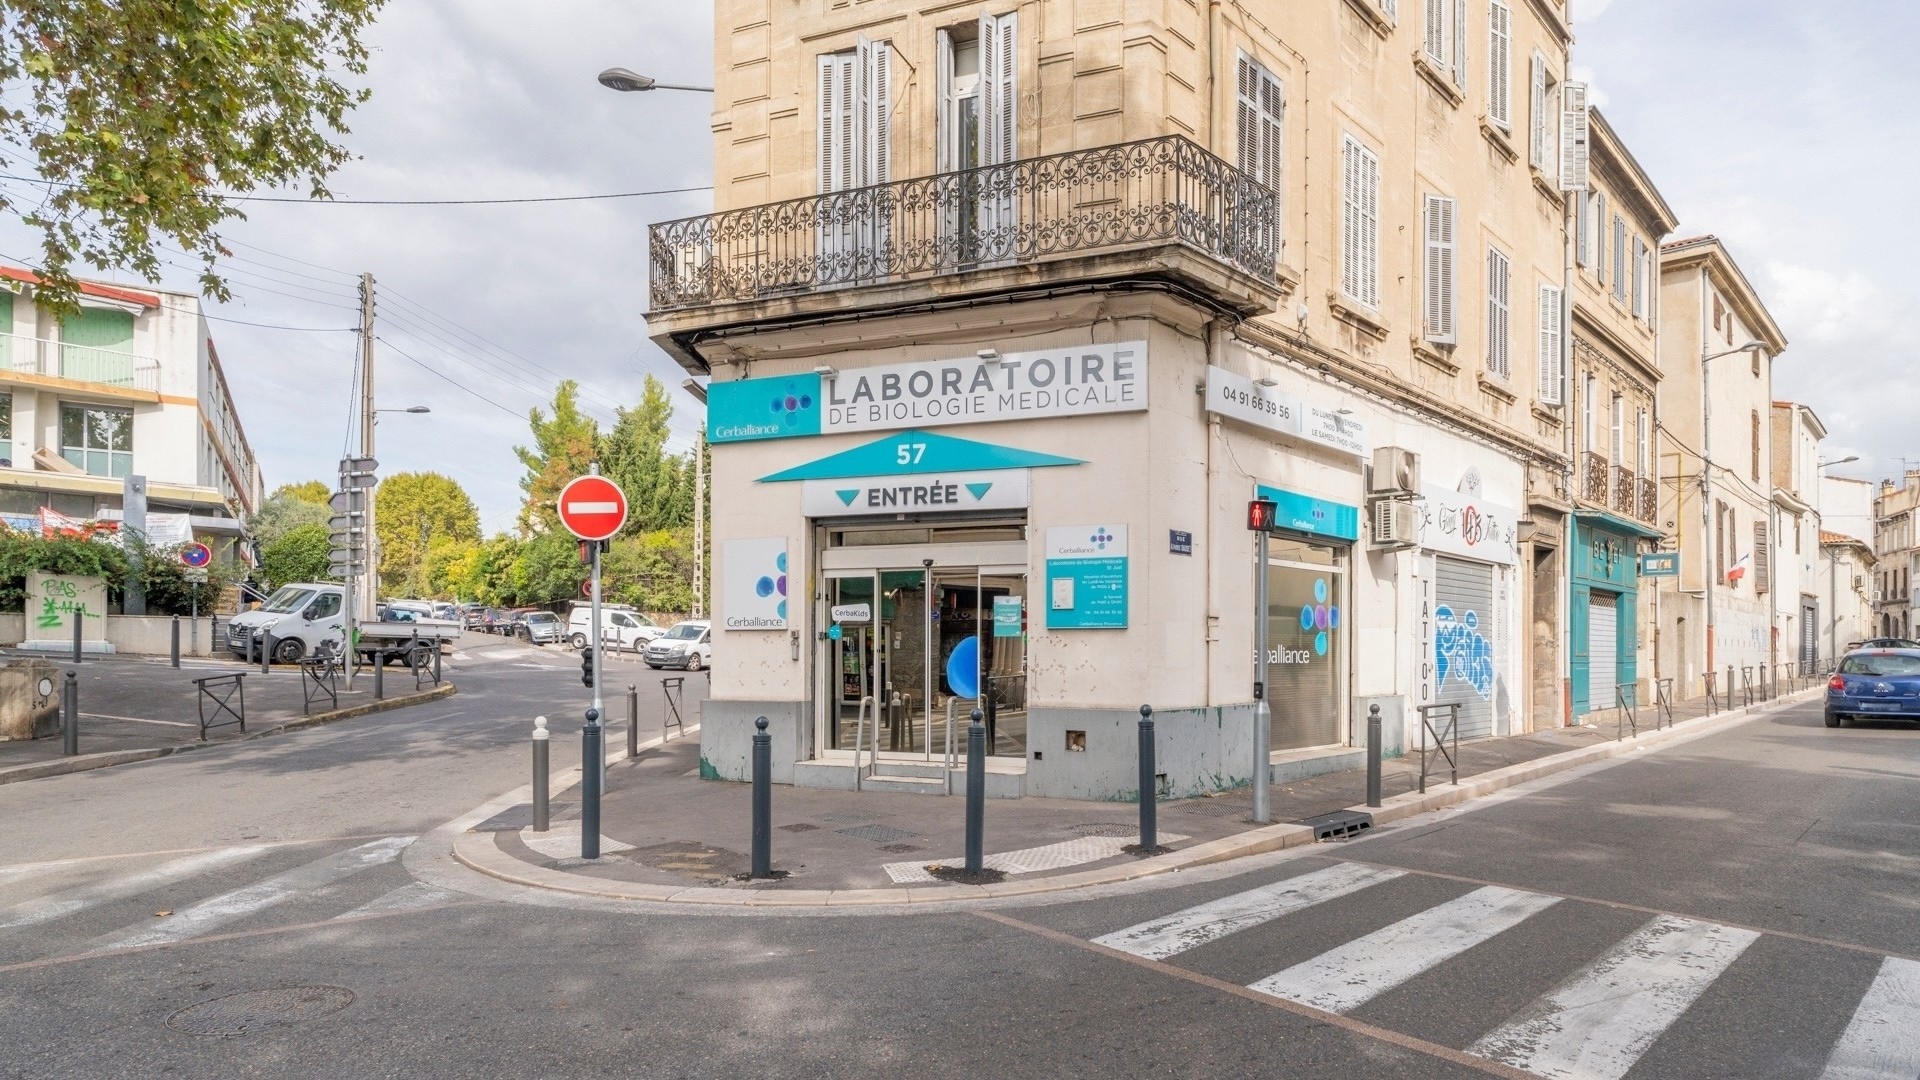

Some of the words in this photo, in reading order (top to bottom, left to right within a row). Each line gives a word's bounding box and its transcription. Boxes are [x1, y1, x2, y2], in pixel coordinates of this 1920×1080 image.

[830, 351, 1134, 405] LABORATOIRE
[830, 407, 857, 425] DE
[870, 396, 985, 421] BIOLOGIE
[999, 383, 1134, 411] MEDICALE
[1223, 386, 1236, 402] 04
[1239, 391, 1249, 406] 91
[1252, 396, 1263, 410] 66
[1266, 401, 1277, 415] 39
[1279, 406, 1290, 419] 56
[716, 424, 779, 437] Cerballiance
[896, 443, 926, 465] 57
[868, 480, 958, 506] ENTRÉE
[727, 616, 782, 627] Cerballiance
[835, 608, 868, 618] CerbaKids
